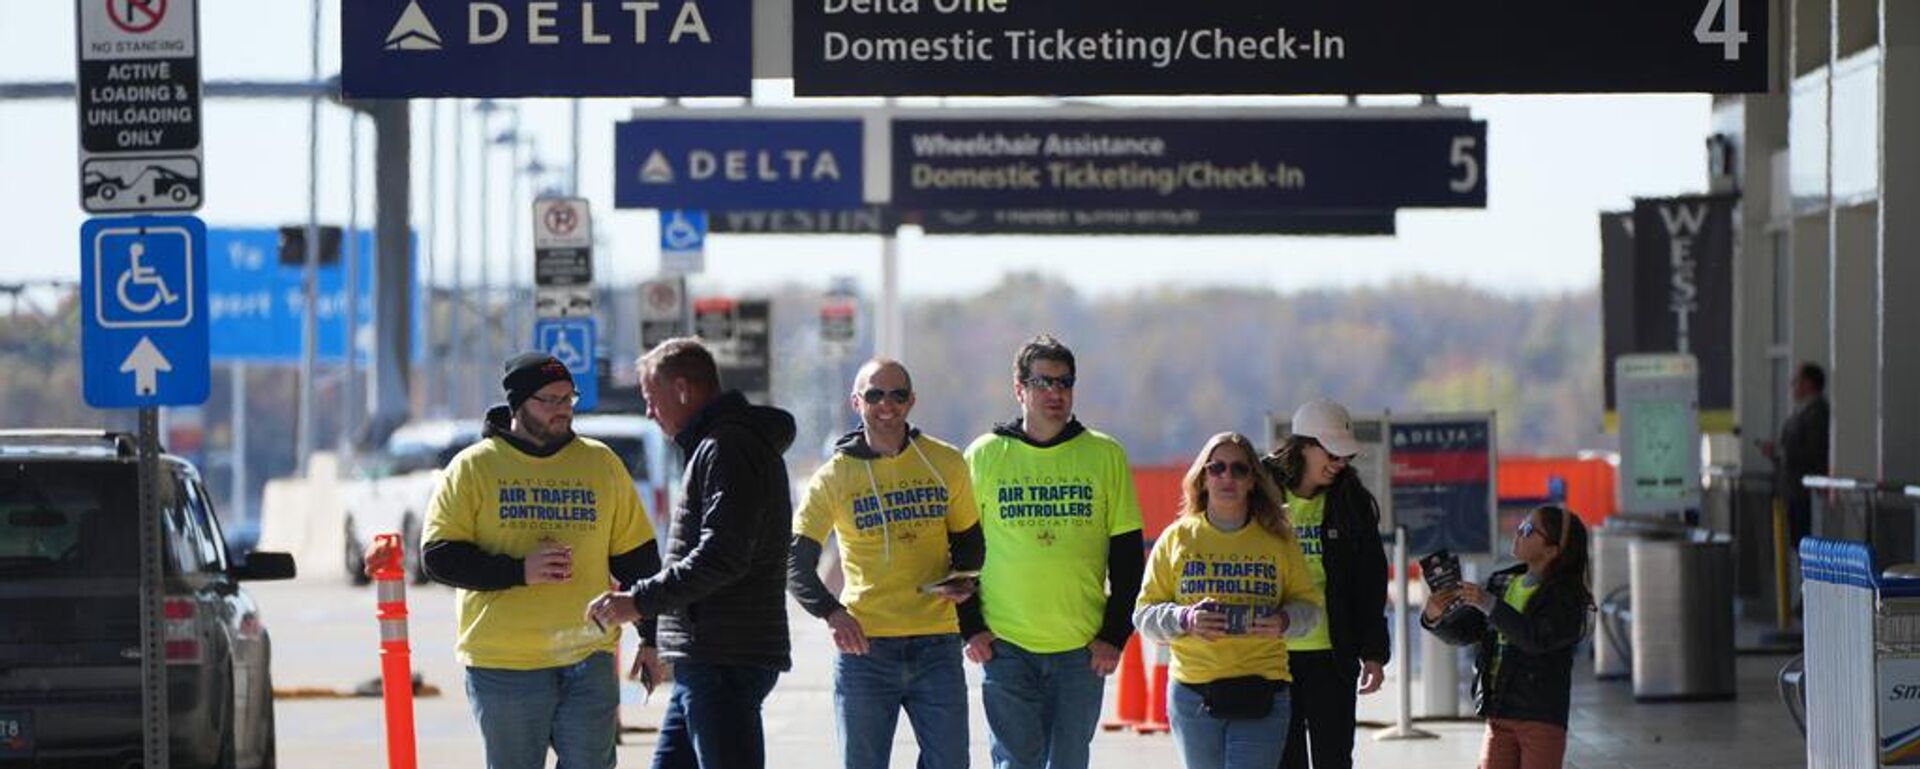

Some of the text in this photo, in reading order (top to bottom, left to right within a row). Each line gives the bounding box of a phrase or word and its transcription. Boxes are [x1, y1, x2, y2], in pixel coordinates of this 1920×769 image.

[469, 2, 711, 44] DELTA
[1694, 0, 1748, 60] 4
[92, 41, 184, 53] NO STANDING
[824, 28, 1345, 68] Domestic Ticketing/Check-In
[108, 63, 170, 80] ACTIVE
[92, 85, 188, 103] LOADING &
[88, 107, 192, 125] UNLOADING
[118, 130, 162, 147] ONLY
[912, 133, 1165, 156] Wheelchair Assistance
[689, 150, 840, 181] DELTA
[1449, 135, 1479, 193] 5
[912, 161, 1305, 195] Domestic Ticketing/Check-In
[499, 487, 596, 504] AIR TRAFFIC
[854, 486, 948, 514] AIR TRAFFIC
[999, 485, 1092, 502] AIR TRAFFIC
[499, 505, 597, 521] CONTROLLERS
[855, 504, 948, 530] CONTROLLER
[1000, 503, 1092, 518] CONTROLLERS
[1183, 561, 1277, 580] AIR TRAFFIC
[1181, 580, 1277, 598] CONTROLLERS
